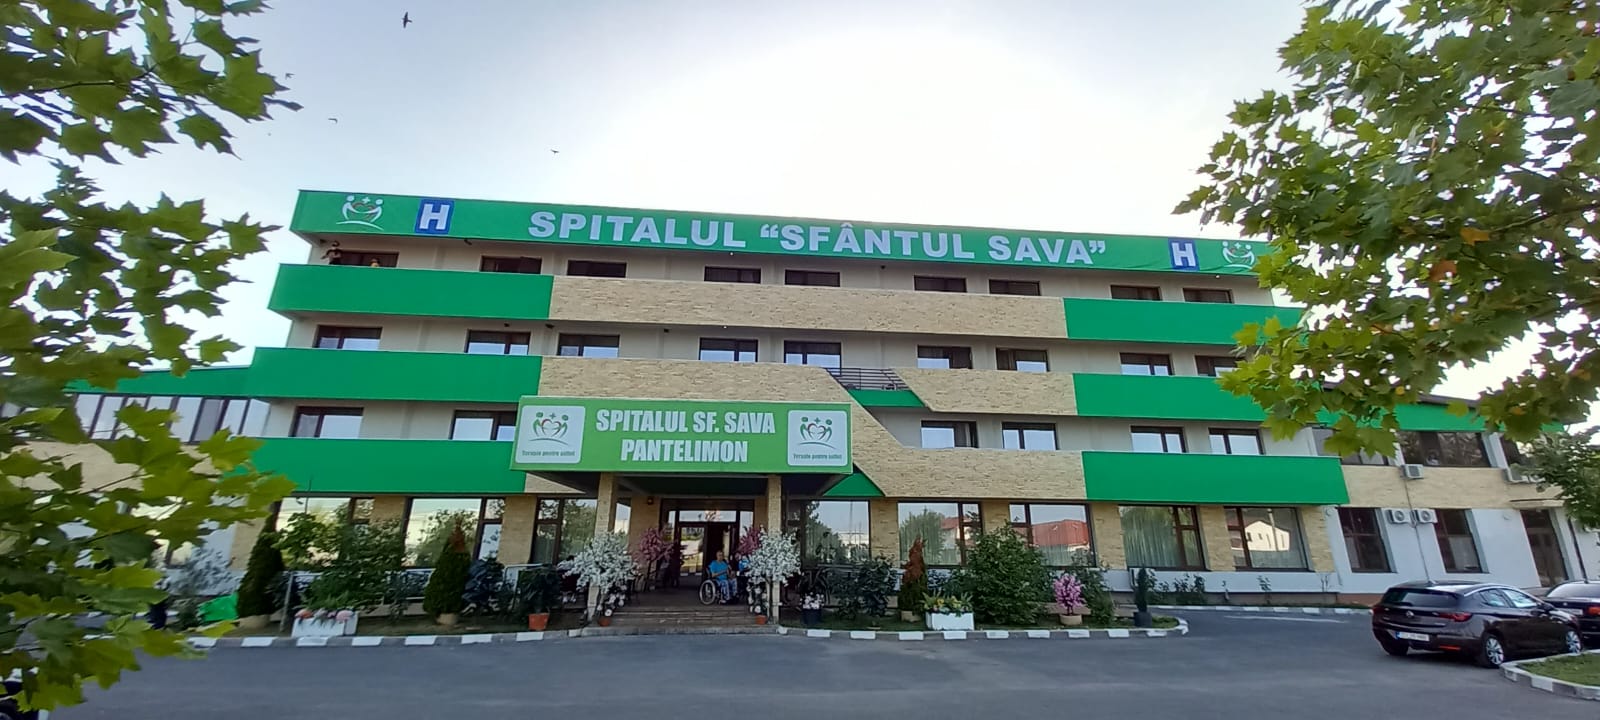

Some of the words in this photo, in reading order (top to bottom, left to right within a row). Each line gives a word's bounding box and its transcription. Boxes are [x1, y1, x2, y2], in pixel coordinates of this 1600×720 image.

[418, 203, 450, 230] H
[528, 211, 746, 247] SPITALUL
[760, 223, 975, 259] “SFÂNTUL
[988, 235, 1106, 265] SAVA”
[1171, 242, 1197, 267] H
[596, 409, 688, 432] SPITALUL
[693, 411, 720, 433] SF.
[724, 412, 776, 433] SAVA
[620, 439, 748, 463] PANTELIMON
